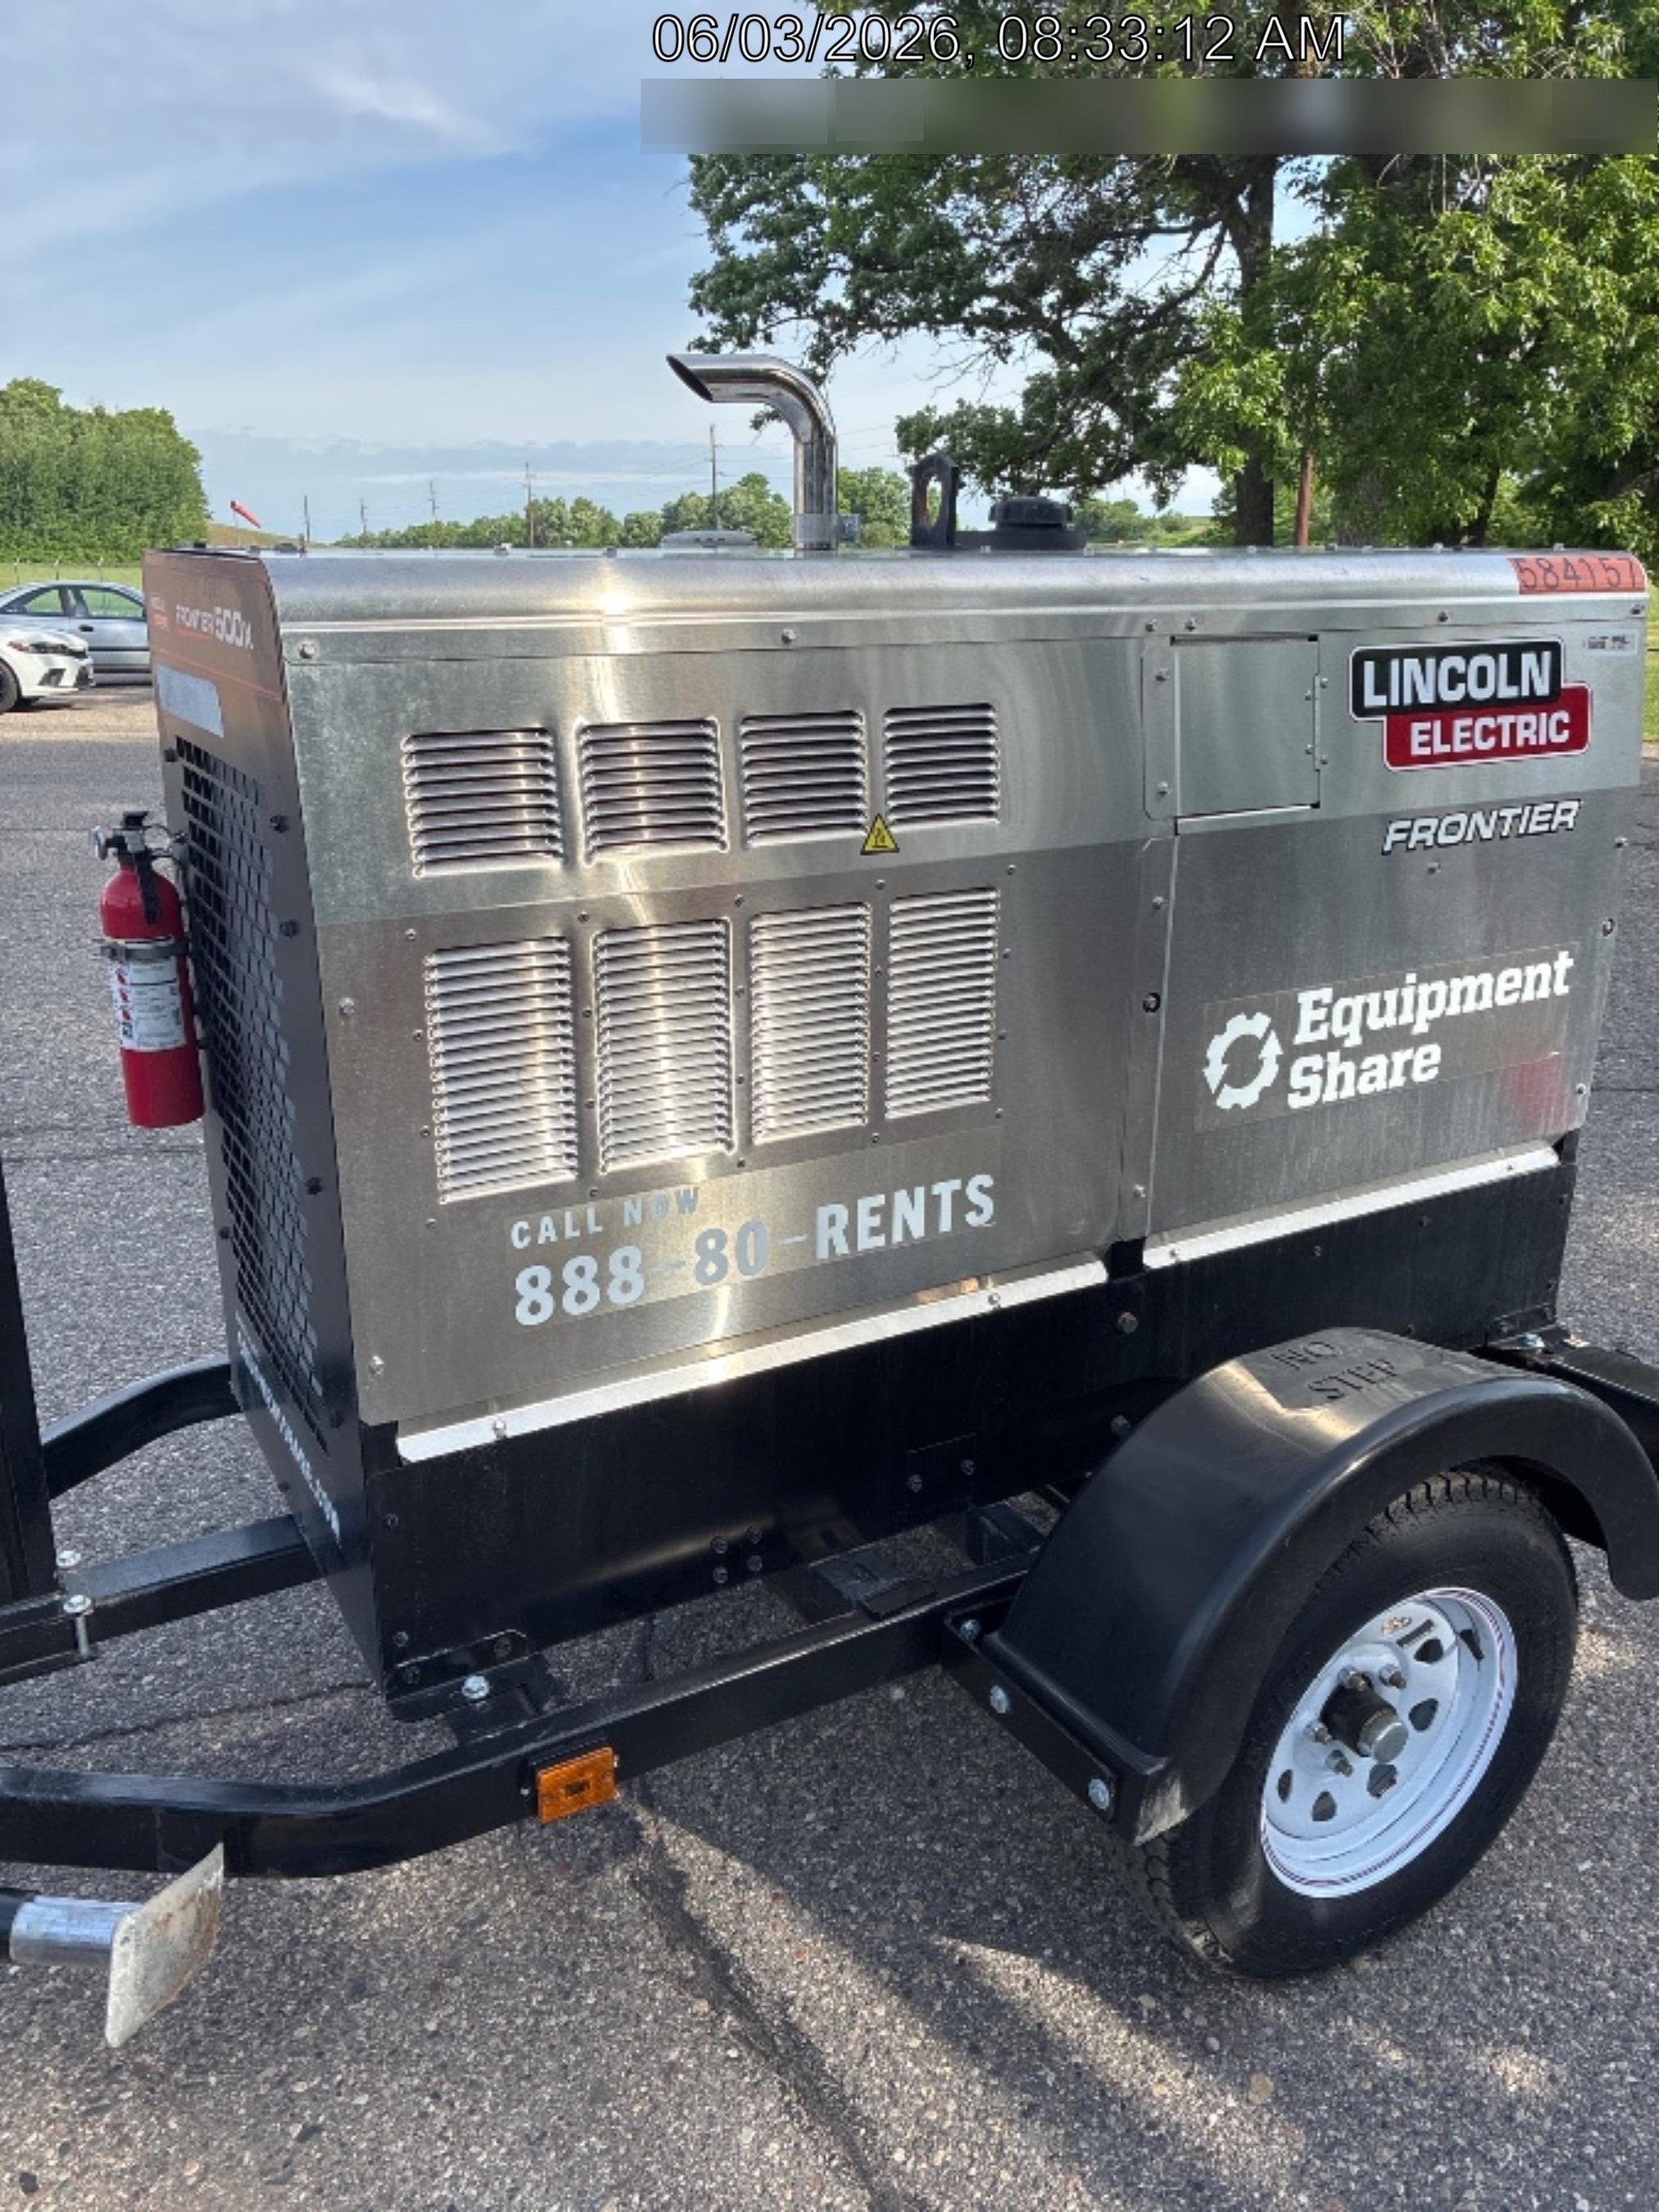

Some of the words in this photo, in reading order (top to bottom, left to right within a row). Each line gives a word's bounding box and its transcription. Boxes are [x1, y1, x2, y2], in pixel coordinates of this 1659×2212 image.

[1512, 556, 1636, 590] 584157
[1363, 651, 1552, 709] LINCOLN
[1410, 711, 1570, 756] ELECTRIC
[1381, 800, 1581, 854] FRONTIER
[1293, 950, 1574, 1047] Equipment
[1287, 1043, 1441, 1109] Share
[510, 1207, 603, 1249] CALL
[623, 1187, 699, 1226] NOW
[1271, 1342, 1337, 1371] NO
[1308, 1358, 1398, 1399] STEP
